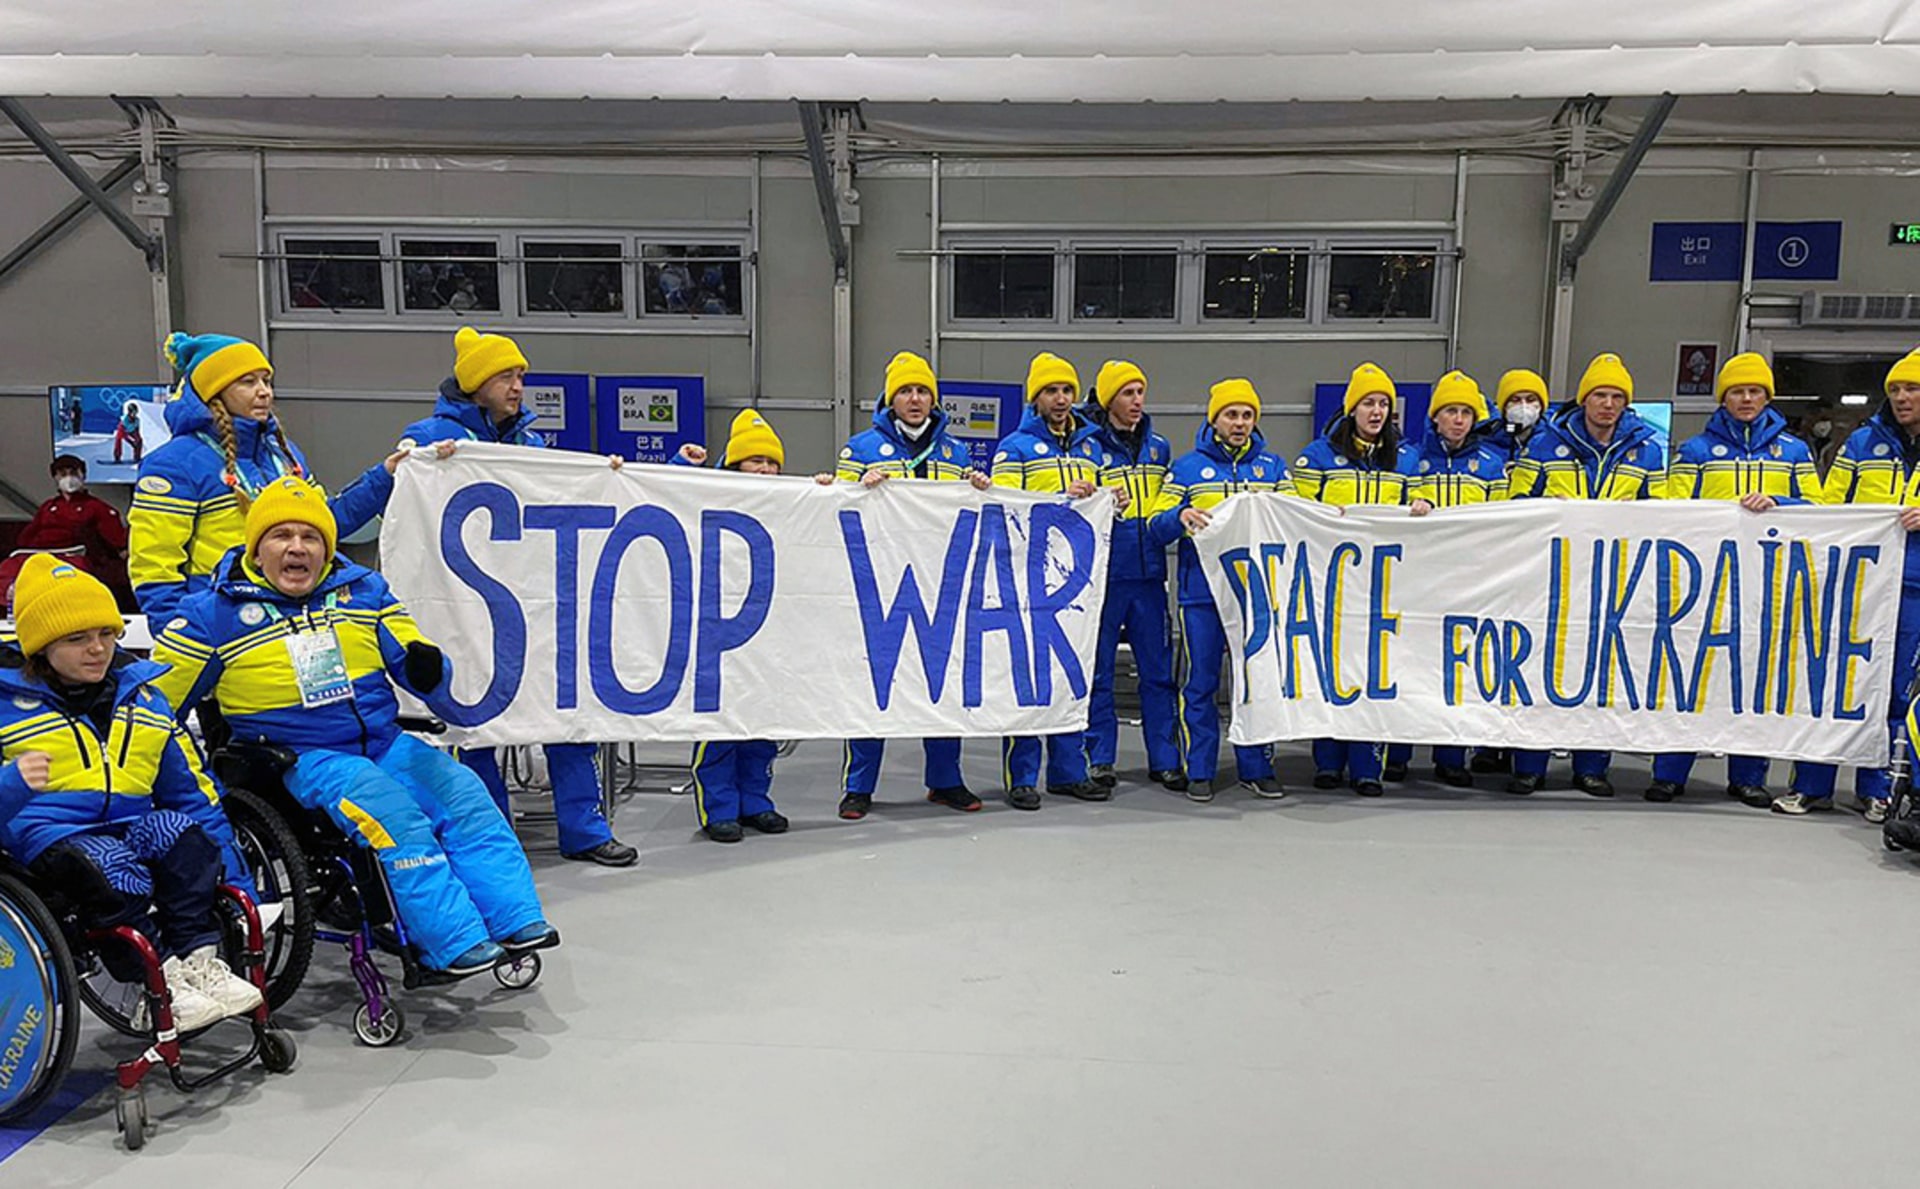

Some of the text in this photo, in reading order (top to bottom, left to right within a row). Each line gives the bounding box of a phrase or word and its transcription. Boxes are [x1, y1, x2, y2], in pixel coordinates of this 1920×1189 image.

[1681, 236, 1710, 251] 出口
[1684, 253, 1707, 266] Exit
[623, 409, 646, 420] BRA
[950, 416, 967, 426] KR
[636, 435, 664, 450] 巴西
[635, 452, 666, 462] Brazil
[427, 482, 1096, 727] STOP WAR
[1218, 527, 1881, 721] PEACE FOR UKRAINE
[0, 1003, 43, 1089] UKRAINE
